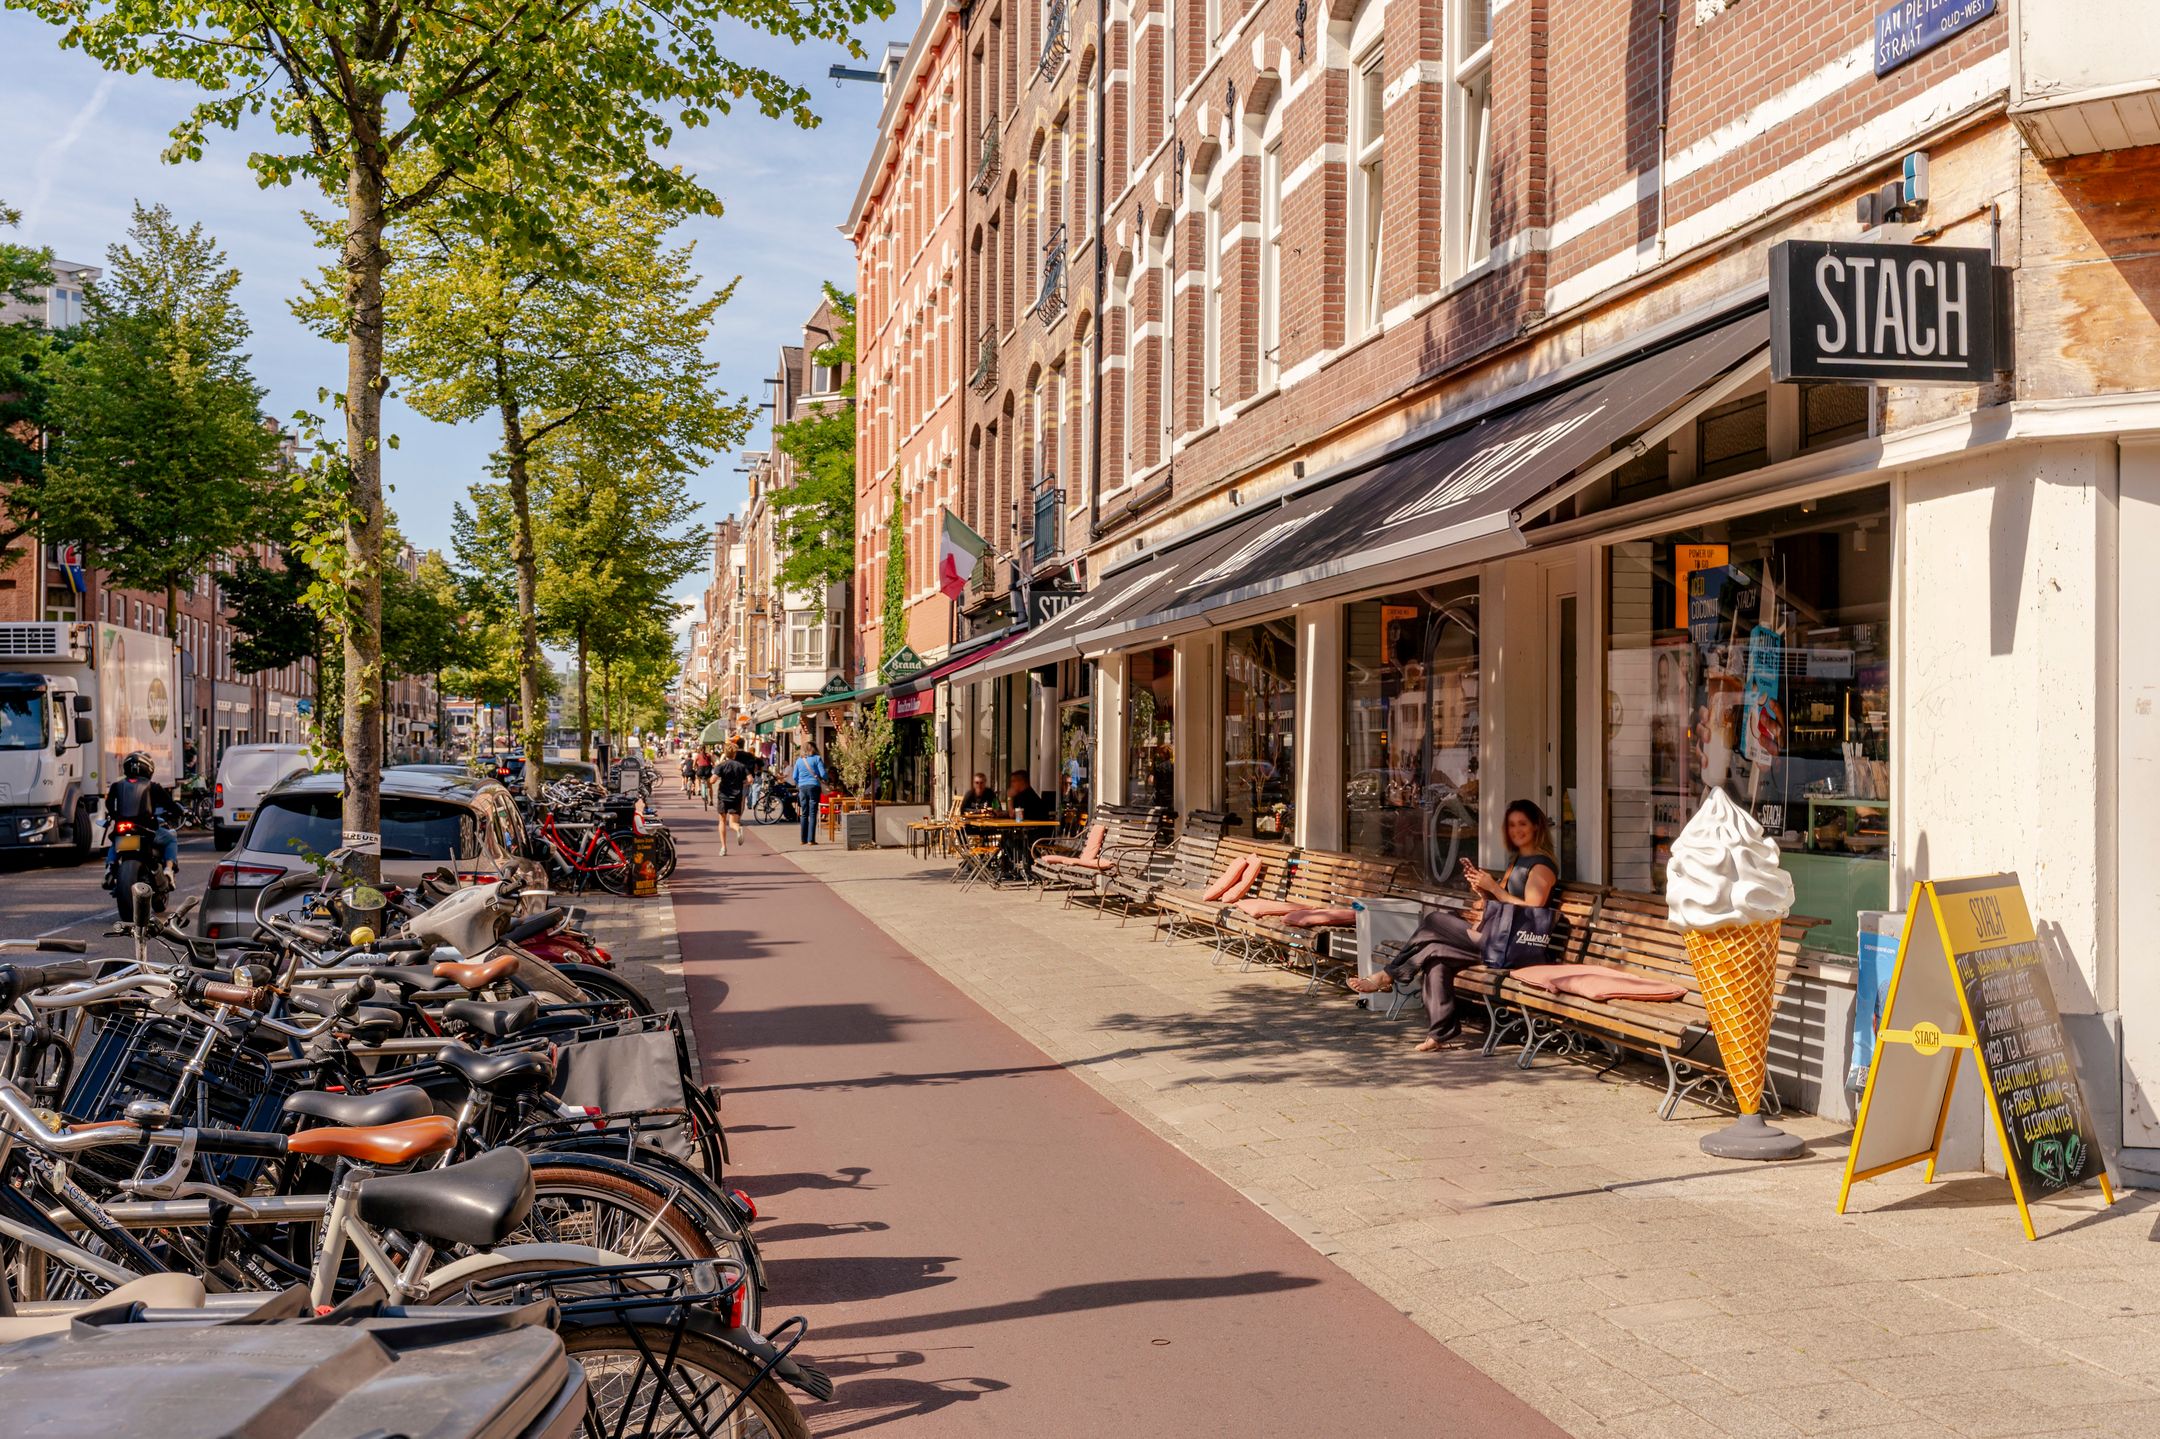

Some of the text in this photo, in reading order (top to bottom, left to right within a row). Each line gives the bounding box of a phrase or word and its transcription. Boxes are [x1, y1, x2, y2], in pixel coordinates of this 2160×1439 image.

[1880, 0, 1949, 46] JAN PIETE
[1940, 0, 1986, 31] OUD-WEST
[1880, 23, 1923, 66] STRAAT
[1815, 254, 1969, 358] STACH
[1038, 596, 1080, 625] STA
[1691, 598, 1719, 620] COCONUT
[1736, 587, 1757, 610] STACH
[1691, 622, 1709, 643] LATTE
[891, 660, 922, 670] Brand
[1761, 804, 1782, 826] STACH
[1969, 895, 2007, 938] STACH
[1957, 953, 1975, 982] THE
[1982, 971, 2034, 1004] COCONUT LATTE
[1986, 1004, 2016, 1035] COCONUT
[1914, 1030, 1939, 1046] STACH
[1987, 1039, 2004, 1065] ICED
[2003, 1035, 2022, 1060] TEA
[2020, 1024, 2055, 1056] LEMONADE
[2038, 1055, 2054, 1080] ICED
[2053, 1051, 2070, 1076] TEA
[2013, 1087, 2037, 1117] FRESH
[2036, 1080, 2064, 1110] LEMON
[2021, 1103, 2074, 1144] ELEKTROLYTES
